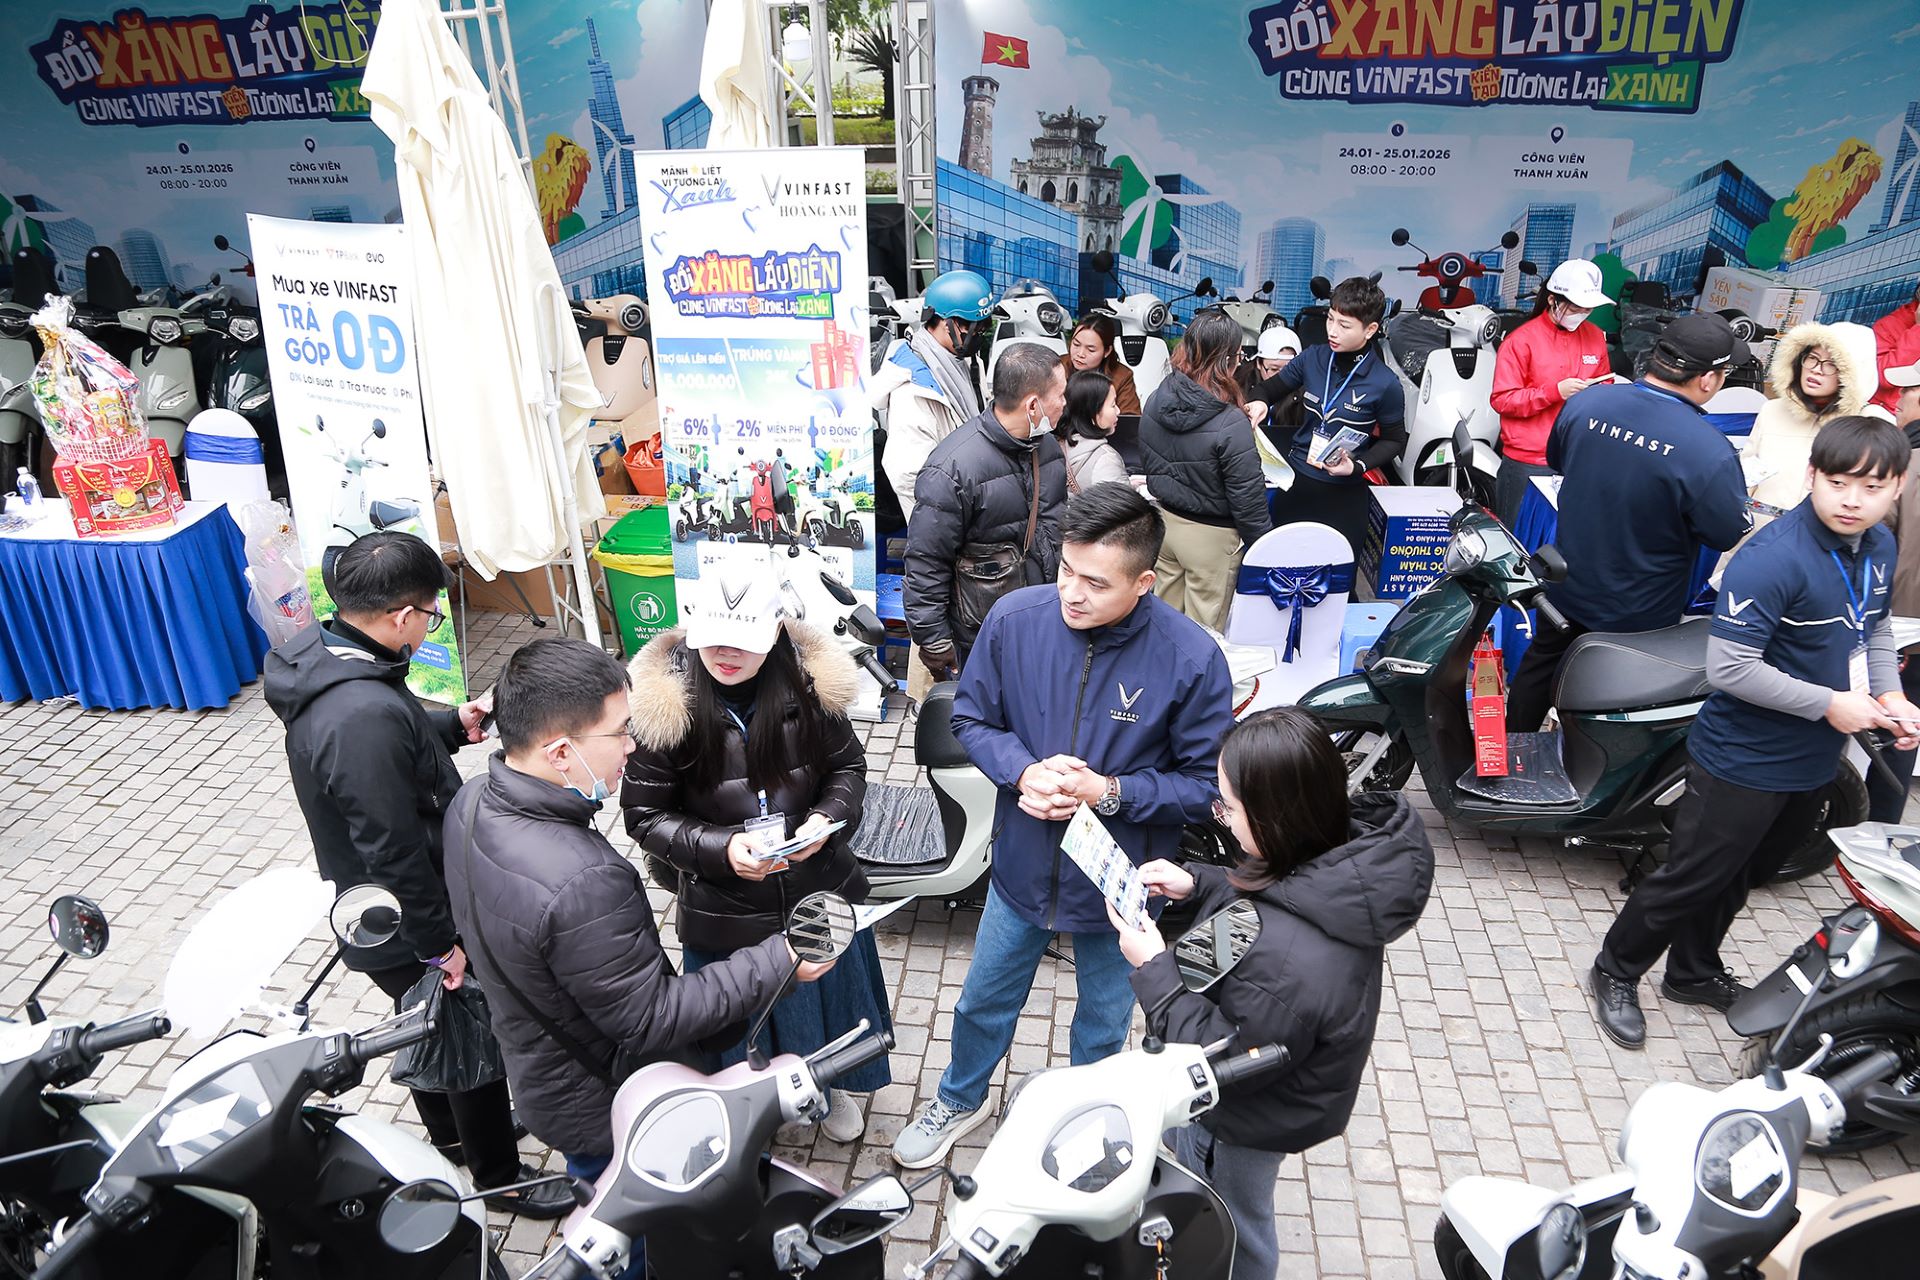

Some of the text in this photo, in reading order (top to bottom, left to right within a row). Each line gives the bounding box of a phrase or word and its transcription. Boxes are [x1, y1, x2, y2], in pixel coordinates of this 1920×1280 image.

[83, 16, 234, 85] XĂNG
[226, 13, 305, 78] LẤY
[1285, 67, 1350, 94] CÙNG
[1500, 68, 1568, 100] TƯƠNG
[1606, 73, 1690, 103] XANH
[1473, 82, 1499, 101] TẠO
[79, 96, 135, 120] CÙNG
[247, 88, 305, 115] TƯƠNG
[334, 89, 370, 114] XA
[1339, 148, 1372, 158] 24.01
[1383, 148, 1451, 160] 25.01.2026
[1521, 151, 1585, 164] CÔNG VIÊN
[146, 165, 171, 175] 24.01
[181, 163, 233, 174] 25.01.2026
[289, 161, 341, 172] CÔNG VIÊN
[1350, 164, 1387, 176] 08:00
[1399, 165, 1436, 176] 20:00
[1514, 168, 1588, 179] THANH XUÂN
[160, 178, 189, 190] 08:00
[199, 178, 227, 188] 20:00
[287, 175, 348, 186] THANH XUÂN
[784, 182, 851, 196] VINFAST
[830, 204, 857, 217] ANH
[366, 252, 385, 263] evo
[688, 252, 752, 294] XĂNG
[753, 255, 789, 292] LẤY
[272, 274, 398, 303] Mua xe VINFAST
[797, 298, 830, 315] XANH
[285, 337, 331, 366] GÓP
[1588, 418, 1675, 456] VINFAST
[1390, 545, 1431, 558] THƯỞNG
[1399, 560, 1428, 572] THĂM
[1390, 574, 1406, 582] ANH
[707, 611, 757, 623] VINFAST
